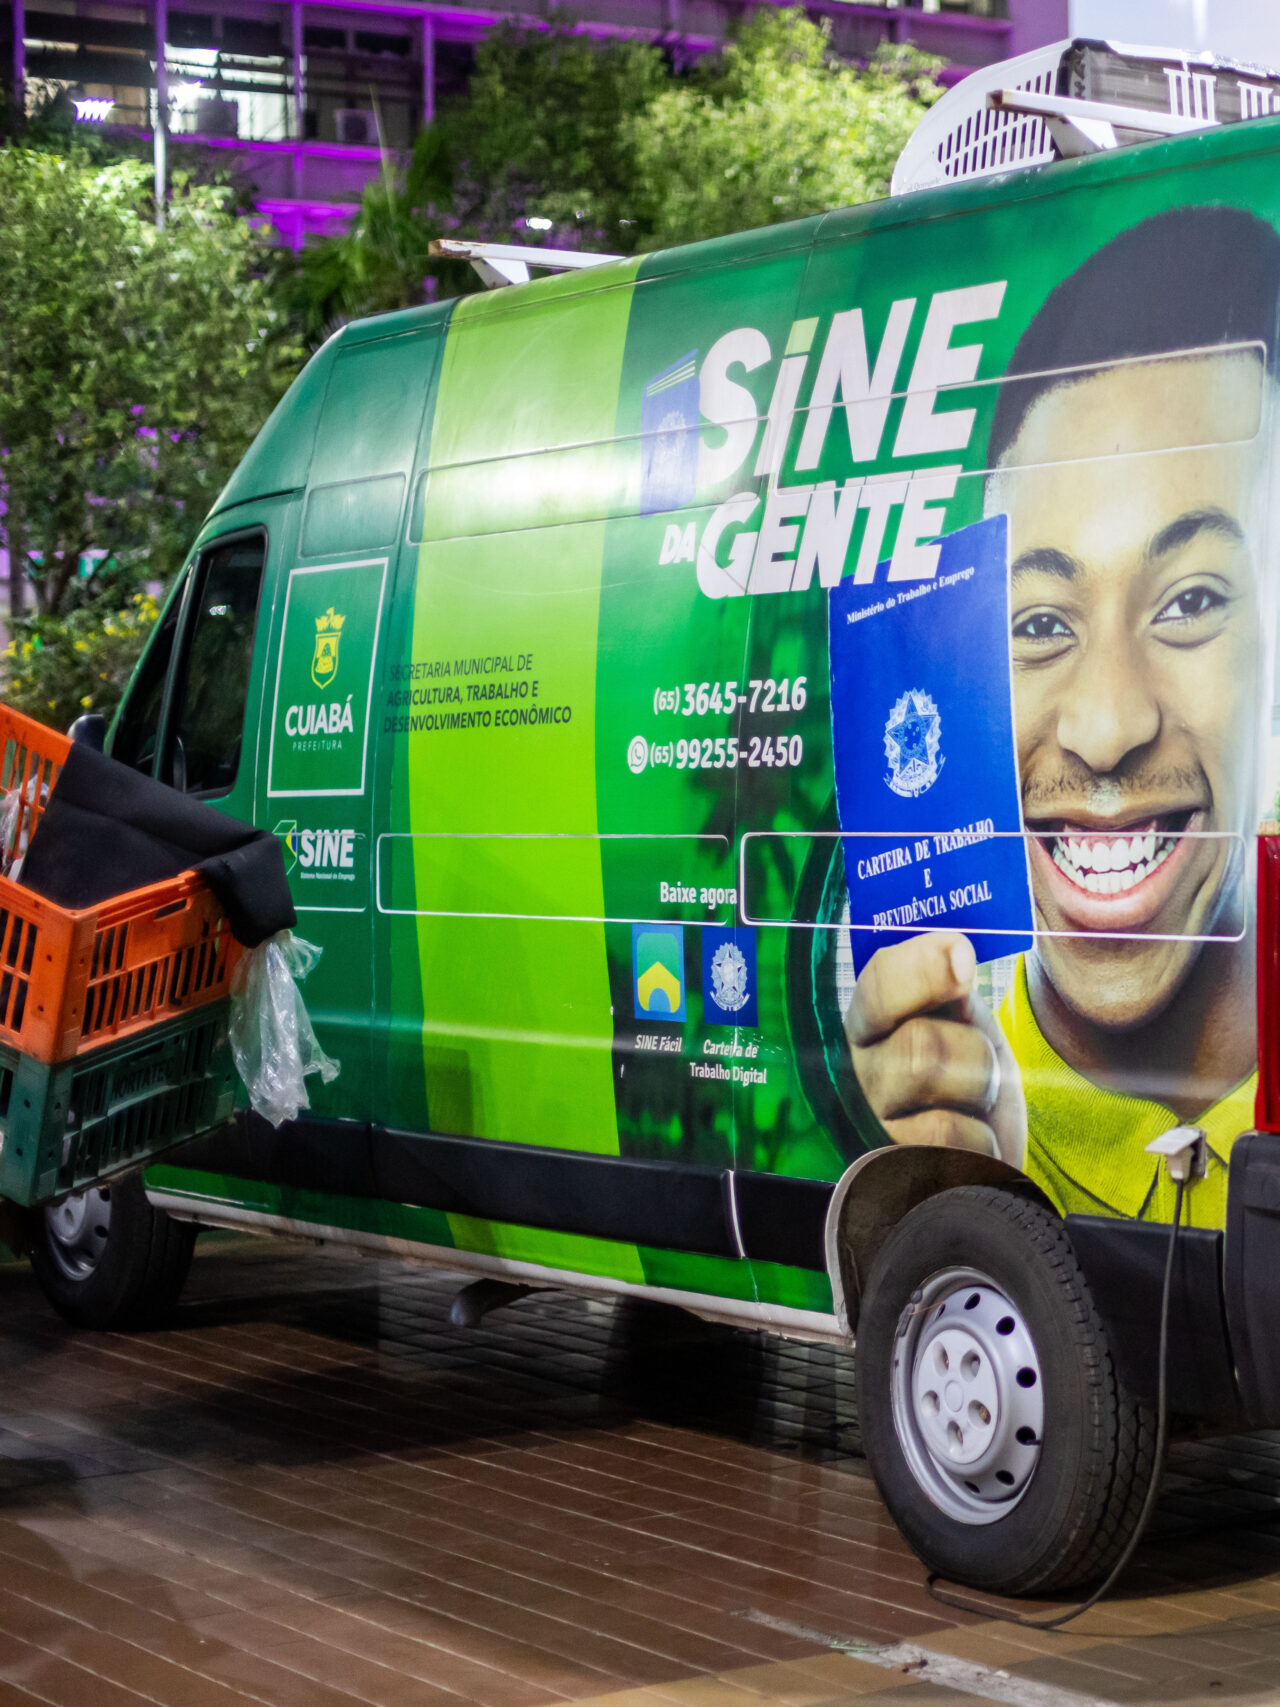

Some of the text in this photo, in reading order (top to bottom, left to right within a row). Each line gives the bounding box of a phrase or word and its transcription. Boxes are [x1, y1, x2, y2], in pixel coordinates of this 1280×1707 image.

[660, 464, 963, 600] DA GENTE
[847, 566, 975, 625] Ministério do Trabalho e Emprego
[389, 653, 534, 682] SECRETARIA MUNICIPAL DE
[386, 680, 540, 708] AGRICULTURA, TRABALHO E
[653, 676, 808, 716] (65) 3645-7216
[285, 694, 354, 736] CUIABÁ
[384, 702, 572, 734] DESENVOLVIMENTO ECONÔMICO
[292, 739, 343, 752] PREFEITURA
[651, 735, 804, 769] (65) 99255-2450
[857, 818, 995, 880] CARTEIRA DE TRABALHO
[923, 868, 933, 888] E
[660, 881, 738, 910] Baixe agora
[873, 880, 993, 933] PREVIDÊNCIA SOCIAL
[634, 1034, 682, 1053] SINE Fácil
[703, 1039, 759, 1059] Carteira de
[689, 1062, 768, 1088] Trabalho Digital
